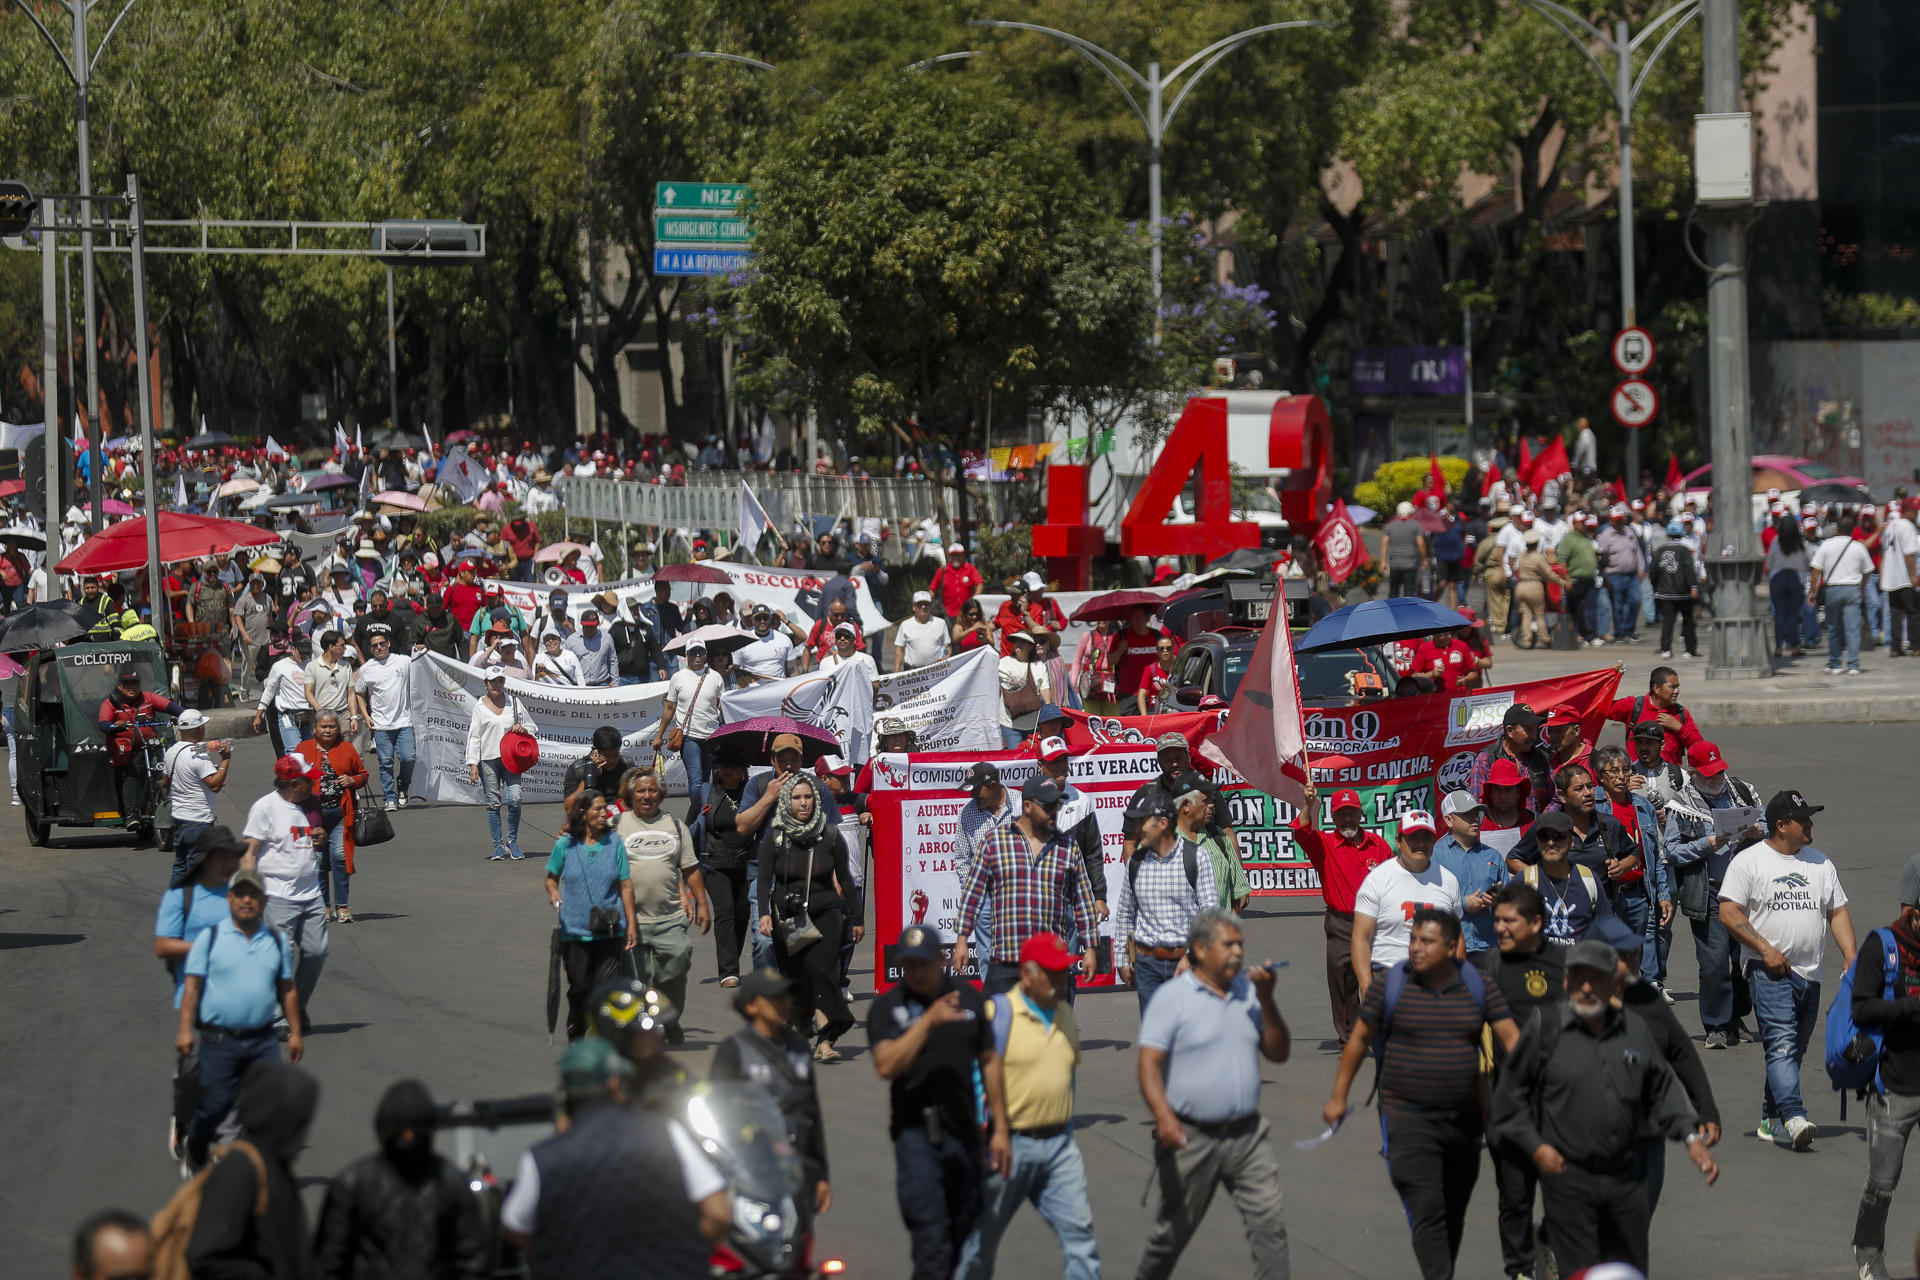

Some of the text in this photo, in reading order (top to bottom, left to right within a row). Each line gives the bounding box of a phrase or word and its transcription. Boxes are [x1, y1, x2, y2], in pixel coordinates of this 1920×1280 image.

[666, 221, 718, 237] INSURGENTES
[682, 254, 695, 270] LA
[74, 653, 132, 666] CICLOTAXI
[897, 675, 930, 687] LABORAL
[433, 688, 466, 702] ISSSTE
[899, 688, 912, 698] NO
[606, 699, 620, 708] DE
[901, 694, 947, 710] INDIVIDUALES
[571, 711, 593, 719] DEL
[903, 706, 956, 722] JUBILACIÓN Y/O
[933, 715, 955, 725] DIGNA
[1351, 710, 1380, 741] 9
[635, 739, 647, 748] LE
[1305, 737, 1400, 753] DEMOCRÁTICA
[547, 752, 580, 761] SINDICAL
[1097, 758, 1161, 776] VERACR
[1311, 767, 1335, 783] EN
[1339, 766, 1362, 782] SU
[1366, 755, 1436, 781] CANCHA:
[1440, 759, 1473, 777] FIFA
[1095, 795, 1132, 809] DIREC
[1374, 785, 1430, 823] LEY
[916, 824, 932, 836] AL
[919, 859, 948, 872] Y LA
[1774, 891, 1812, 901] MCNEIL
[942, 898, 953, 910] NI
[1767, 901, 1819, 912] FOOTBALL
[889, 967, 900, 978] EL
